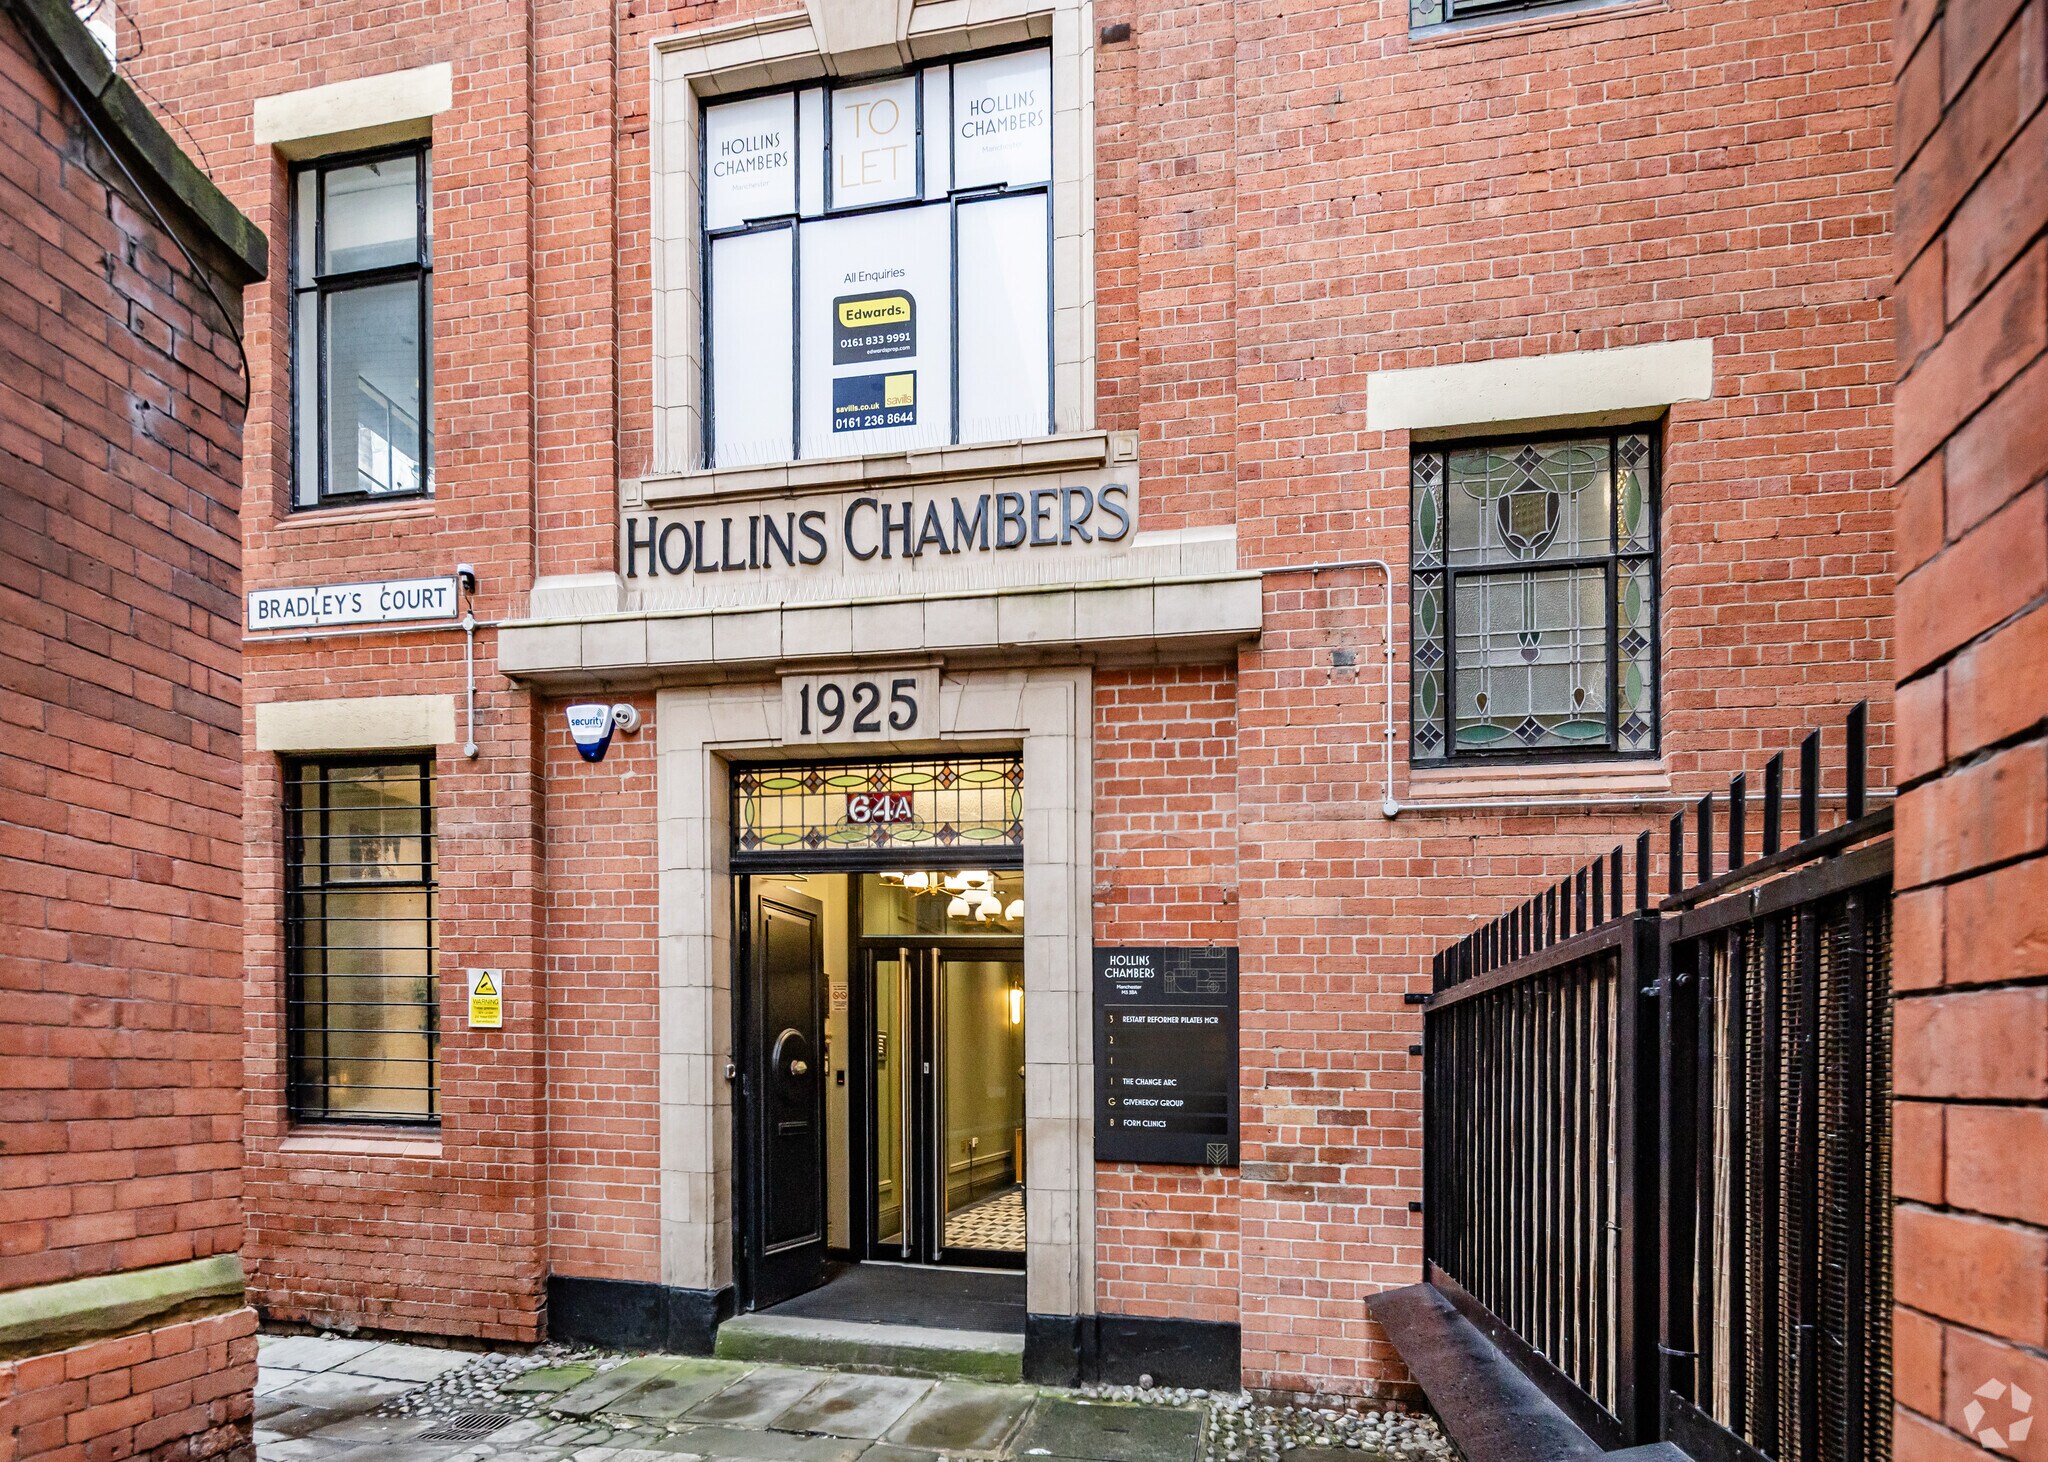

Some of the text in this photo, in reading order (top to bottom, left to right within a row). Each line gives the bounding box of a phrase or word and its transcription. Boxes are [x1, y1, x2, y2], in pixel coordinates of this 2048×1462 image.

[970, 90, 1035, 116] HOLLINS
[845, 98, 900, 139] TO
[961, 109, 1044, 139] CHAMBERS
[721, 131, 780, 156] HOLLINS
[713, 150, 788, 178] CHAMBERS
[840, 144, 909, 189] LET
[843, 267, 906, 284] All Enquiries
[846, 304, 906, 321] Edwards.
[840, 332, 911, 348] 0161 833 9991
[835, 402, 880, 413] savills.co.uk
[886, 393, 913, 406] savills
[835, 411, 914, 430] 0161 236 8644
[626, 483, 1130, 579] HOLLINS CHAMBERS
[258, 587, 447, 620] BRADLEY'S COURT
[799, 678, 919, 736] 1925
[571, 716, 604, 728] security
[849, 795, 912, 823] 64A
[1109, 955, 1150, 966] HOLLINS
[1104, 967, 1155, 979] CHAMBERS
[1109, 1015, 1114, 1024] 3
[1147, 1016, 1179, 1024] REFORMER
[1180, 1016, 1203, 1024] PILATES
[1109, 1036, 1114, 1044] 2
[1135, 1078, 1162, 1086] CHANGE
[1108, 1097, 1116, 1106] G
[1160, 1099, 1184, 1107] GROUP
